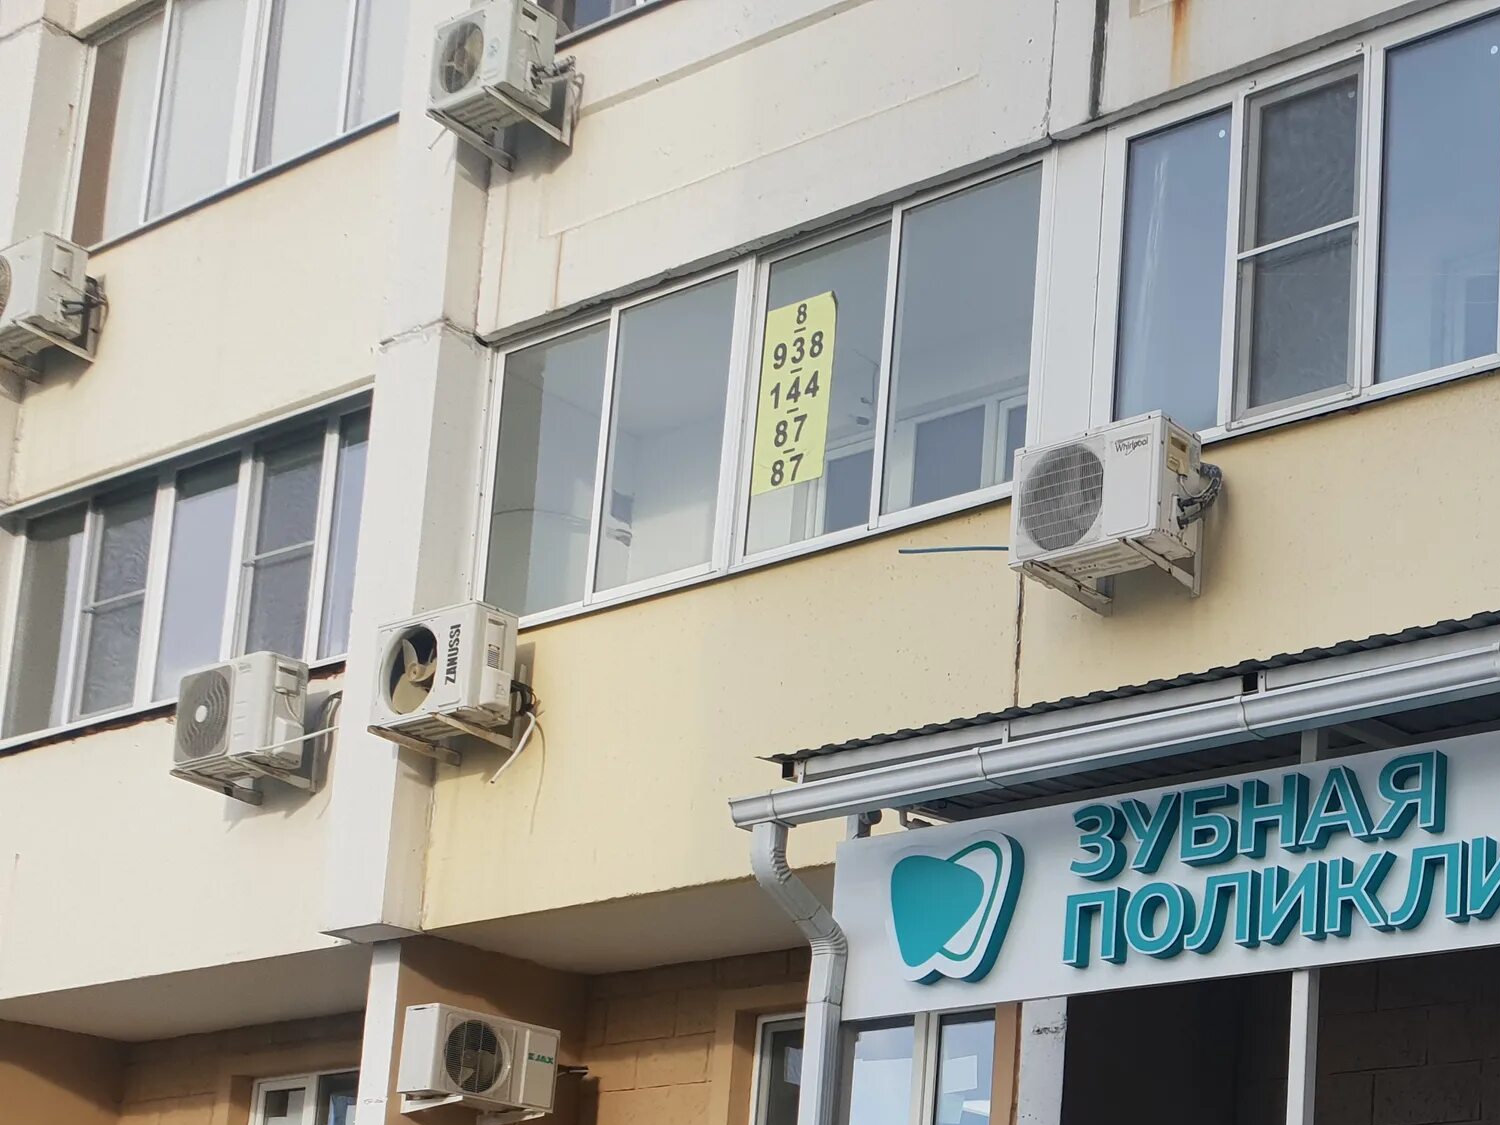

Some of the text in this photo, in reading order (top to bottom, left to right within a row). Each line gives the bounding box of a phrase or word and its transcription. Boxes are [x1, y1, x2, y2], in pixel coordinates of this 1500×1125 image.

[795, 303, 808, 325] 8
[773, 330, 825, 370] 938
[770, 370, 820, 410] 144
[774, 413, 808, 448] 87
[1114, 436, 1150, 454] Whirlpool
[770, 453, 804, 487] 87
[444, 623, 462, 686] ZANUSSI
[1069, 749, 1448, 882] ЗУБНАЯ
